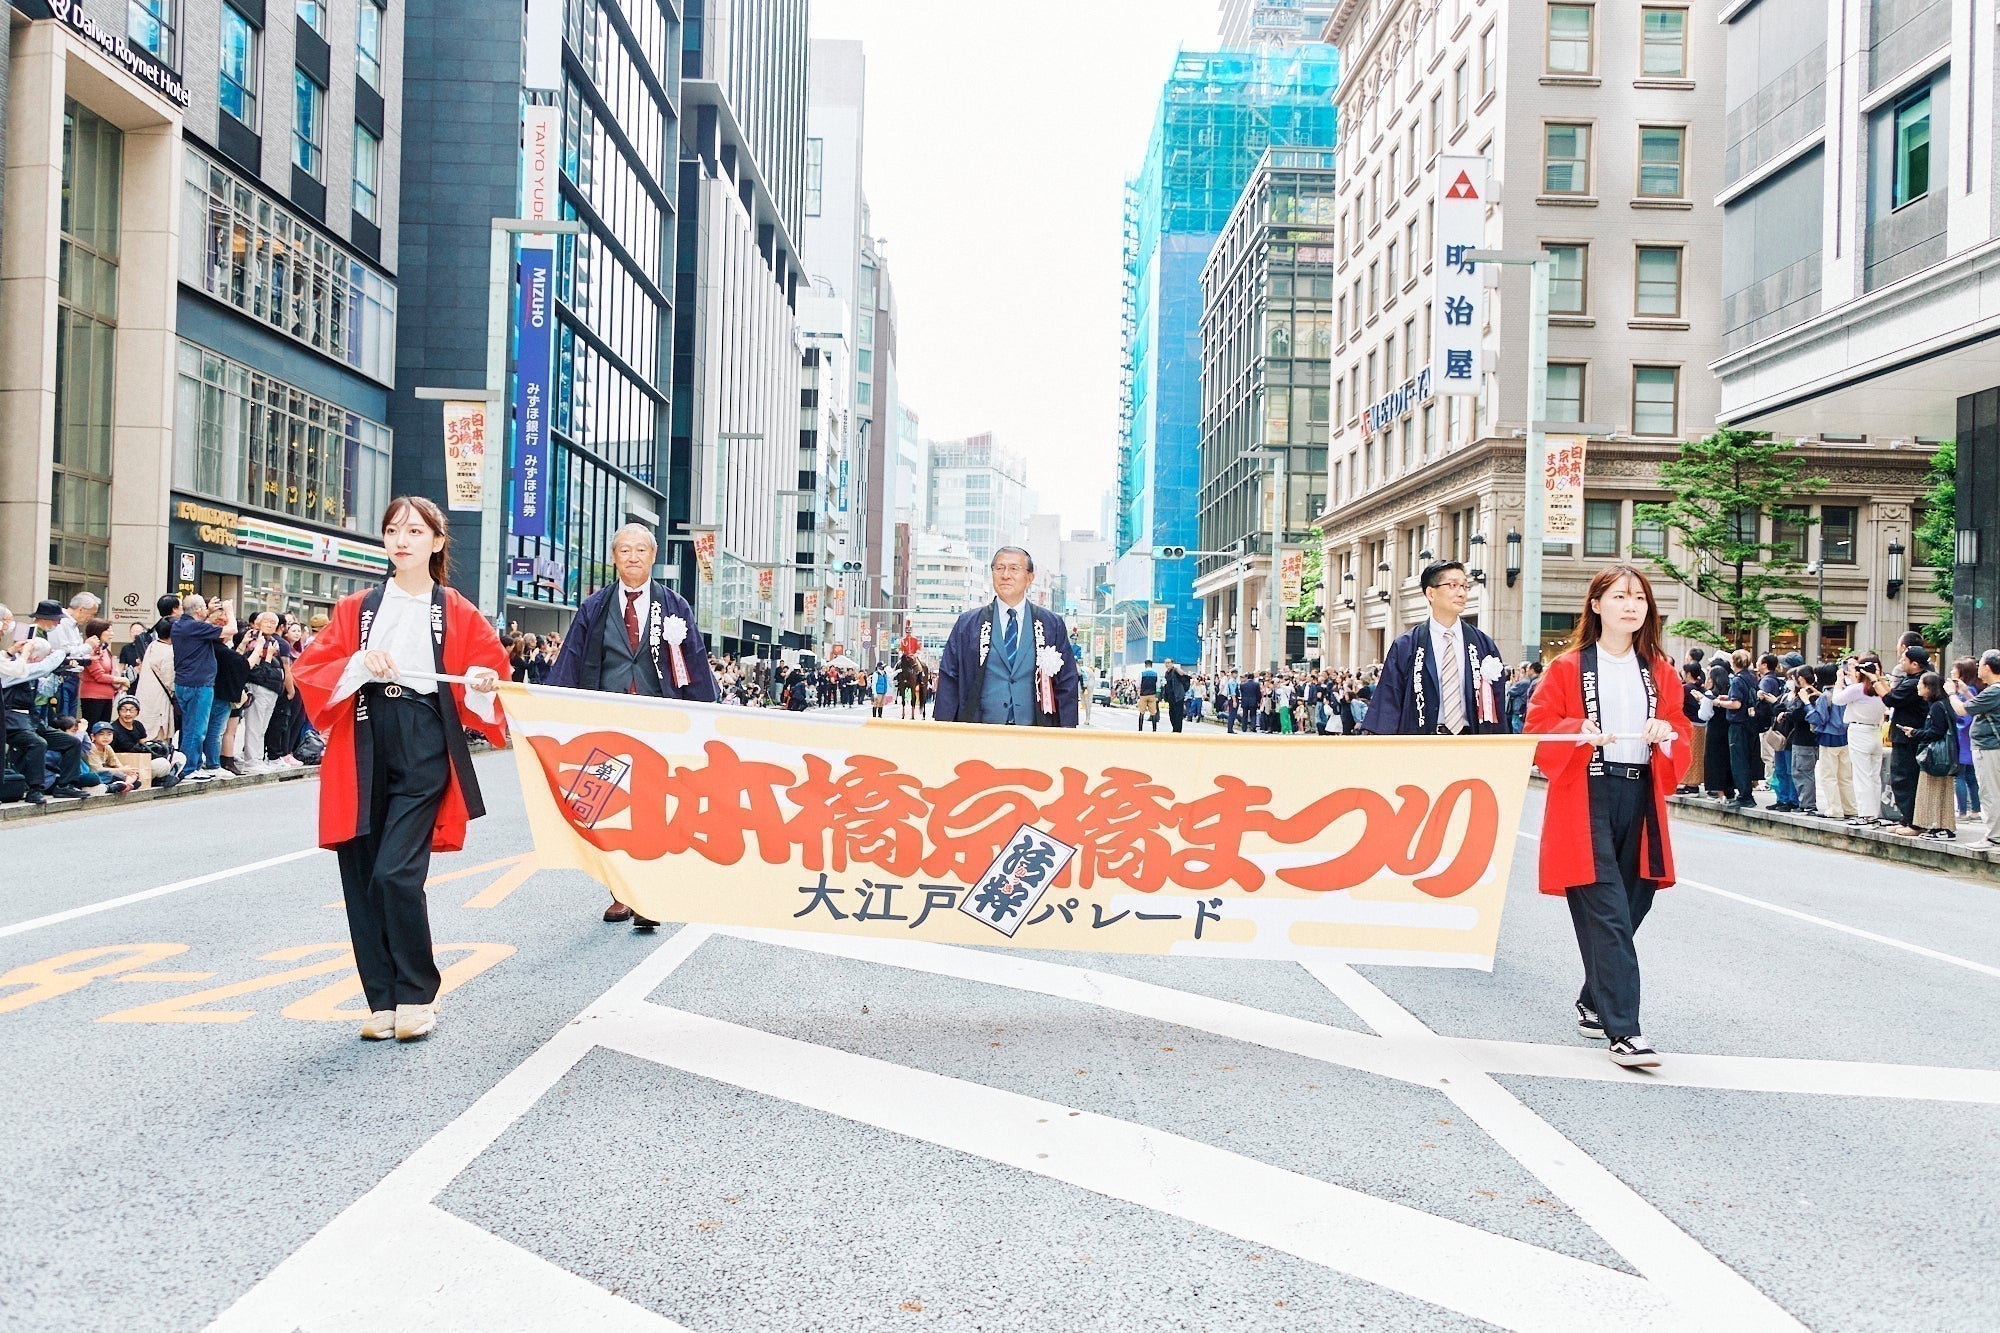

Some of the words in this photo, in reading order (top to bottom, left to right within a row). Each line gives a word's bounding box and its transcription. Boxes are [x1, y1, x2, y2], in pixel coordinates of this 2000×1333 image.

[72, 3, 113, 52] Daiwa
[115, 36, 160, 85] Roynet
[161, 69, 192, 108] Hotel
[535, 121, 546, 171] TAIYO
[533, 177, 544, 236] YUDE
[531, 267, 546, 328] MIZUHO
[1444, 243, 1476, 380] 明治屋
[447, 421, 460, 459] まつり
[471, 413, 484, 455] 日本橋
[525, 382, 540, 446] みずほ銀行
[523, 454, 538, 518] みずほ証券
[1545, 453, 1557, 491] まつり
[1568, 445, 1583, 488] 日本橋
[198, 524, 237, 547] Coffee
[526, 730, 1499, 899] 日本橋京橋まつり
[571, 761, 617, 821] 第51回
[793, 872, 966, 930] 大江戸
[1026, 897, 1224, 940] パレード
